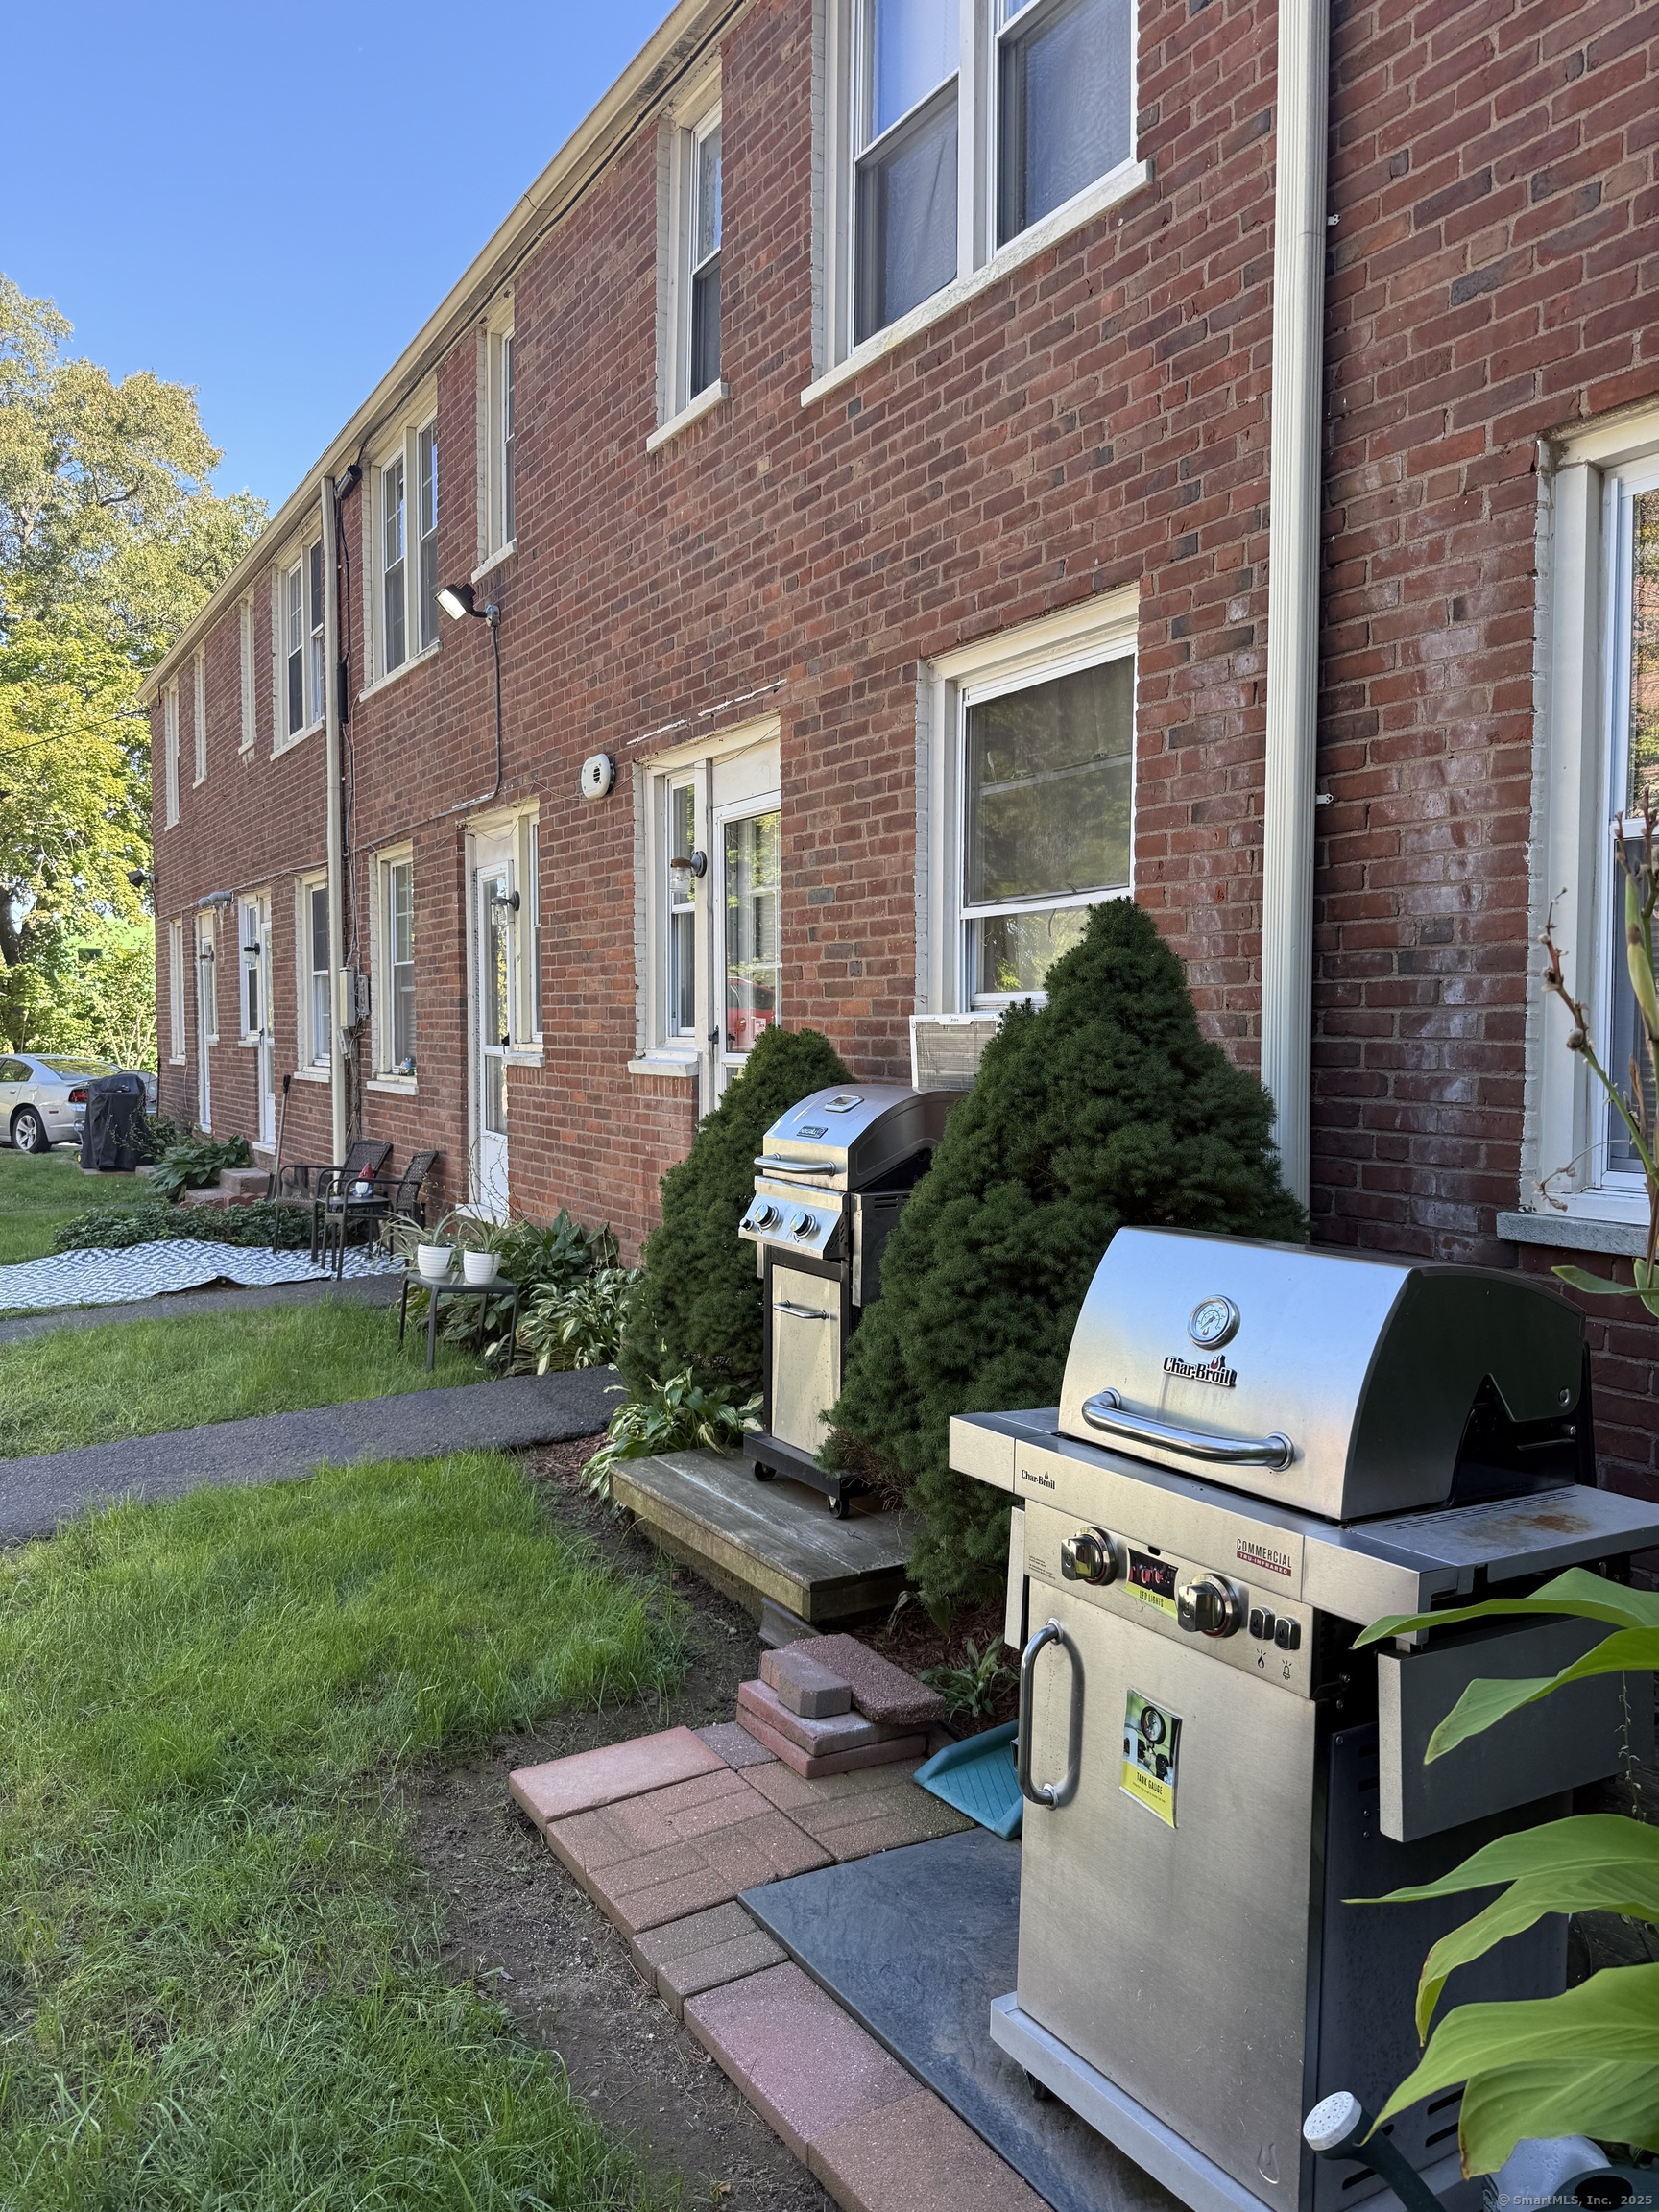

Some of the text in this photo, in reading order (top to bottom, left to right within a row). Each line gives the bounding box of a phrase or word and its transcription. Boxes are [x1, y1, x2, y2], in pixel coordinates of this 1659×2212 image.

[1237, 1538, 1291, 1568] COMMERCIAL
[1239, 1552, 1288, 1575] TRU-INFRARED
[1139, 1589, 1164, 1608] LED LIGHTS
[1137, 1771, 1147, 1786] TANK
[1148, 1779, 1163, 1795] GAUGE
